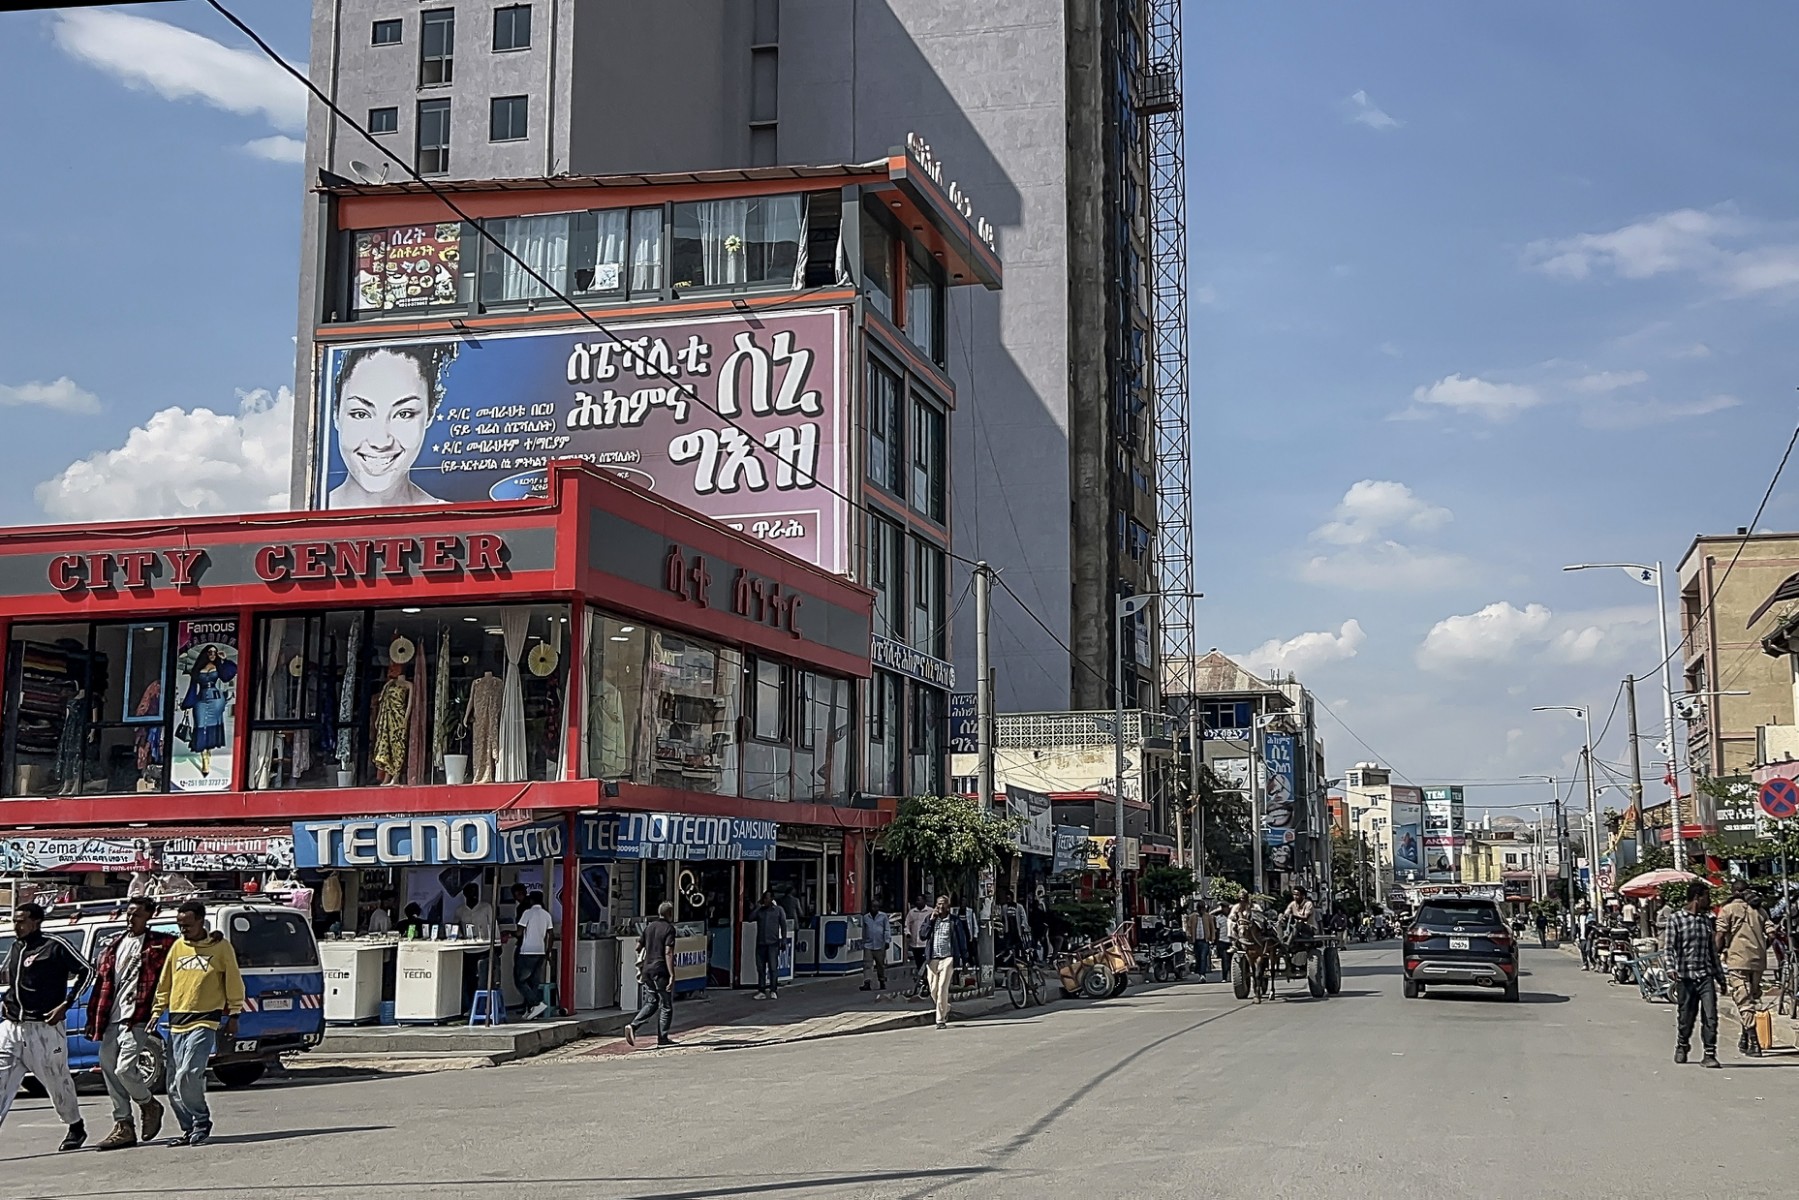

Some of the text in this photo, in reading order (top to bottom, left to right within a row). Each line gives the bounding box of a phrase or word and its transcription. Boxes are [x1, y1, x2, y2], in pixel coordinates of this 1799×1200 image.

[567, 334, 709, 381] ስፔሻሊቲ
[718, 331, 820, 414] ስኒ
[566, 385, 694, 427] ሕክምና
[48, 534, 507, 593] CITY CENTER
[187, 622, 235, 634] Famous
[1425, 790, 1446, 800] TEM
[304, 816, 491, 865] TECNO
[501, 824, 561, 864] TECNO
[668, 814, 731, 845] TECNO
[733, 820, 777, 841] SAMSUNG
[39, 841, 77, 854] Zema
[673, 950, 706, 967] SAMSUNG
[403, 971, 432, 979] TECNO
